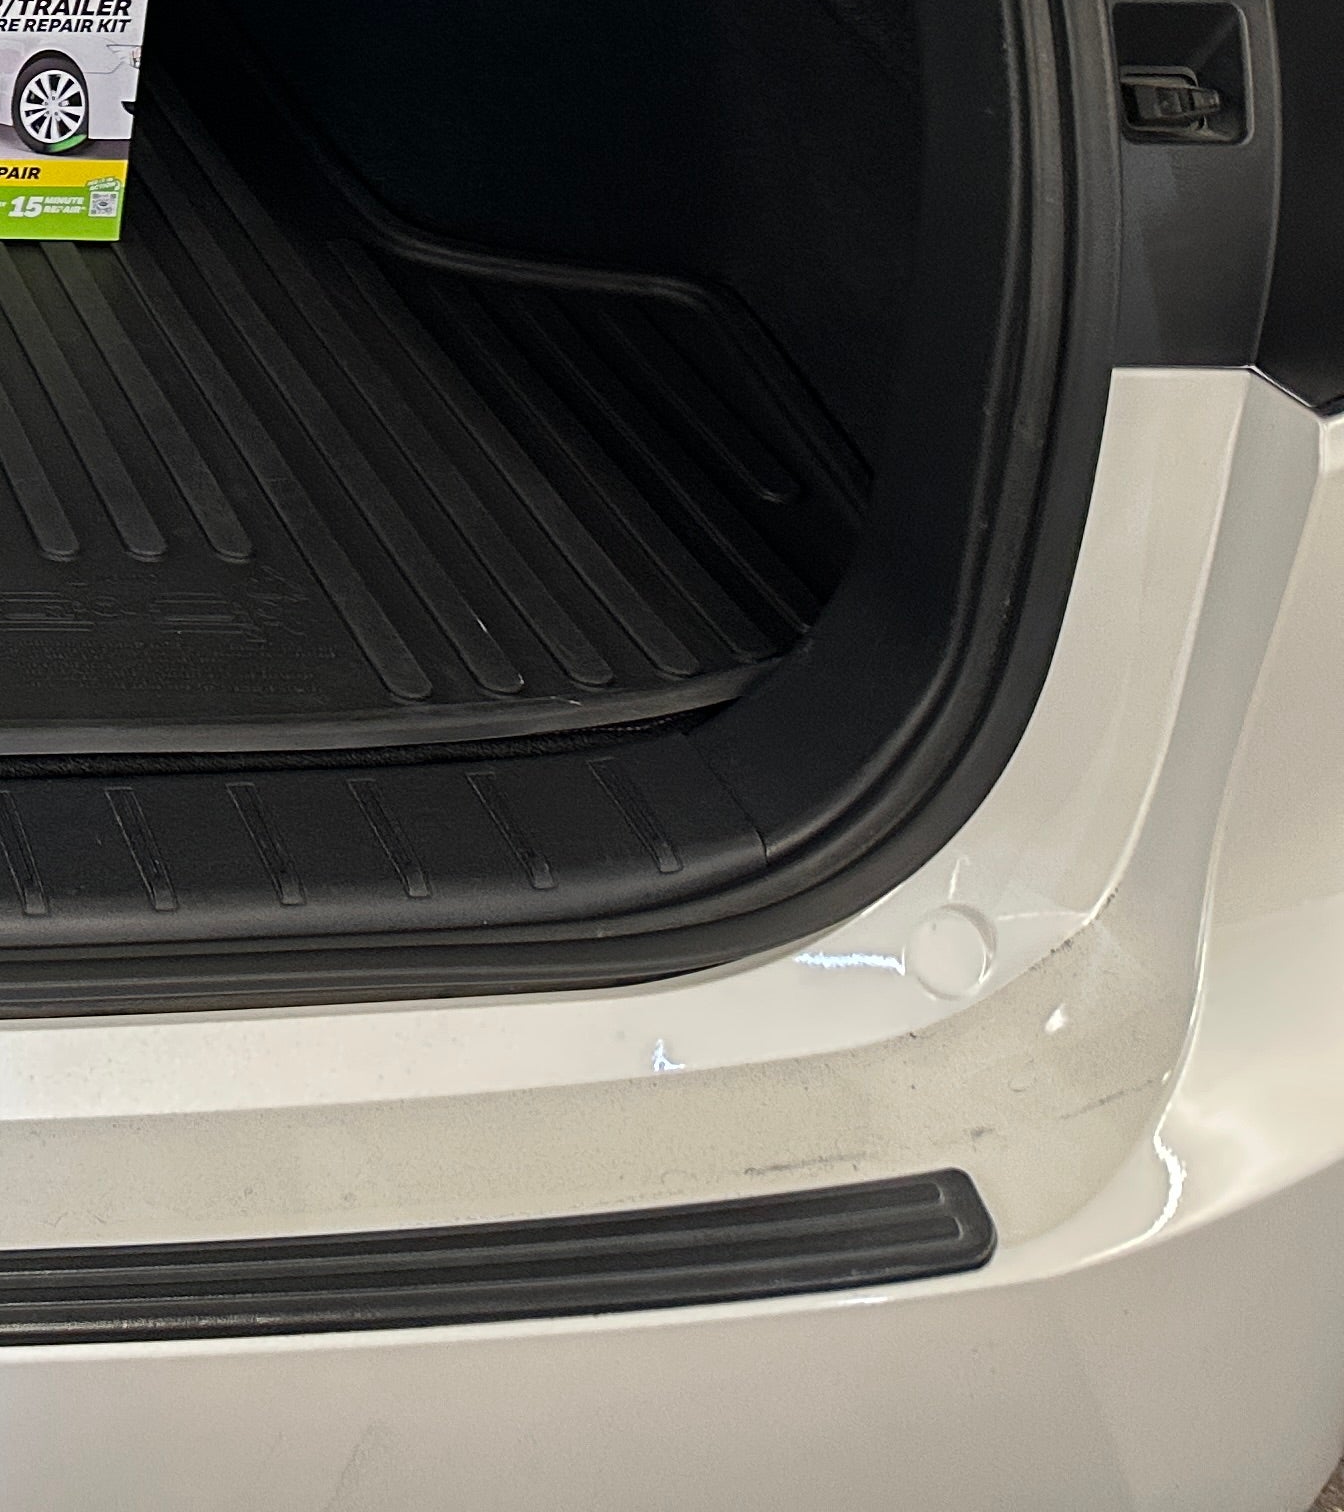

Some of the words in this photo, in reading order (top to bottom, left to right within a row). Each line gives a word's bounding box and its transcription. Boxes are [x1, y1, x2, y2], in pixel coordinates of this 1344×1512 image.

[22, 18, 94, 33] REPAIR
[96, 18, 133, 33] KIT
[7, 195, 44, 218] 15
[44, 196, 85, 204] MINUTE
